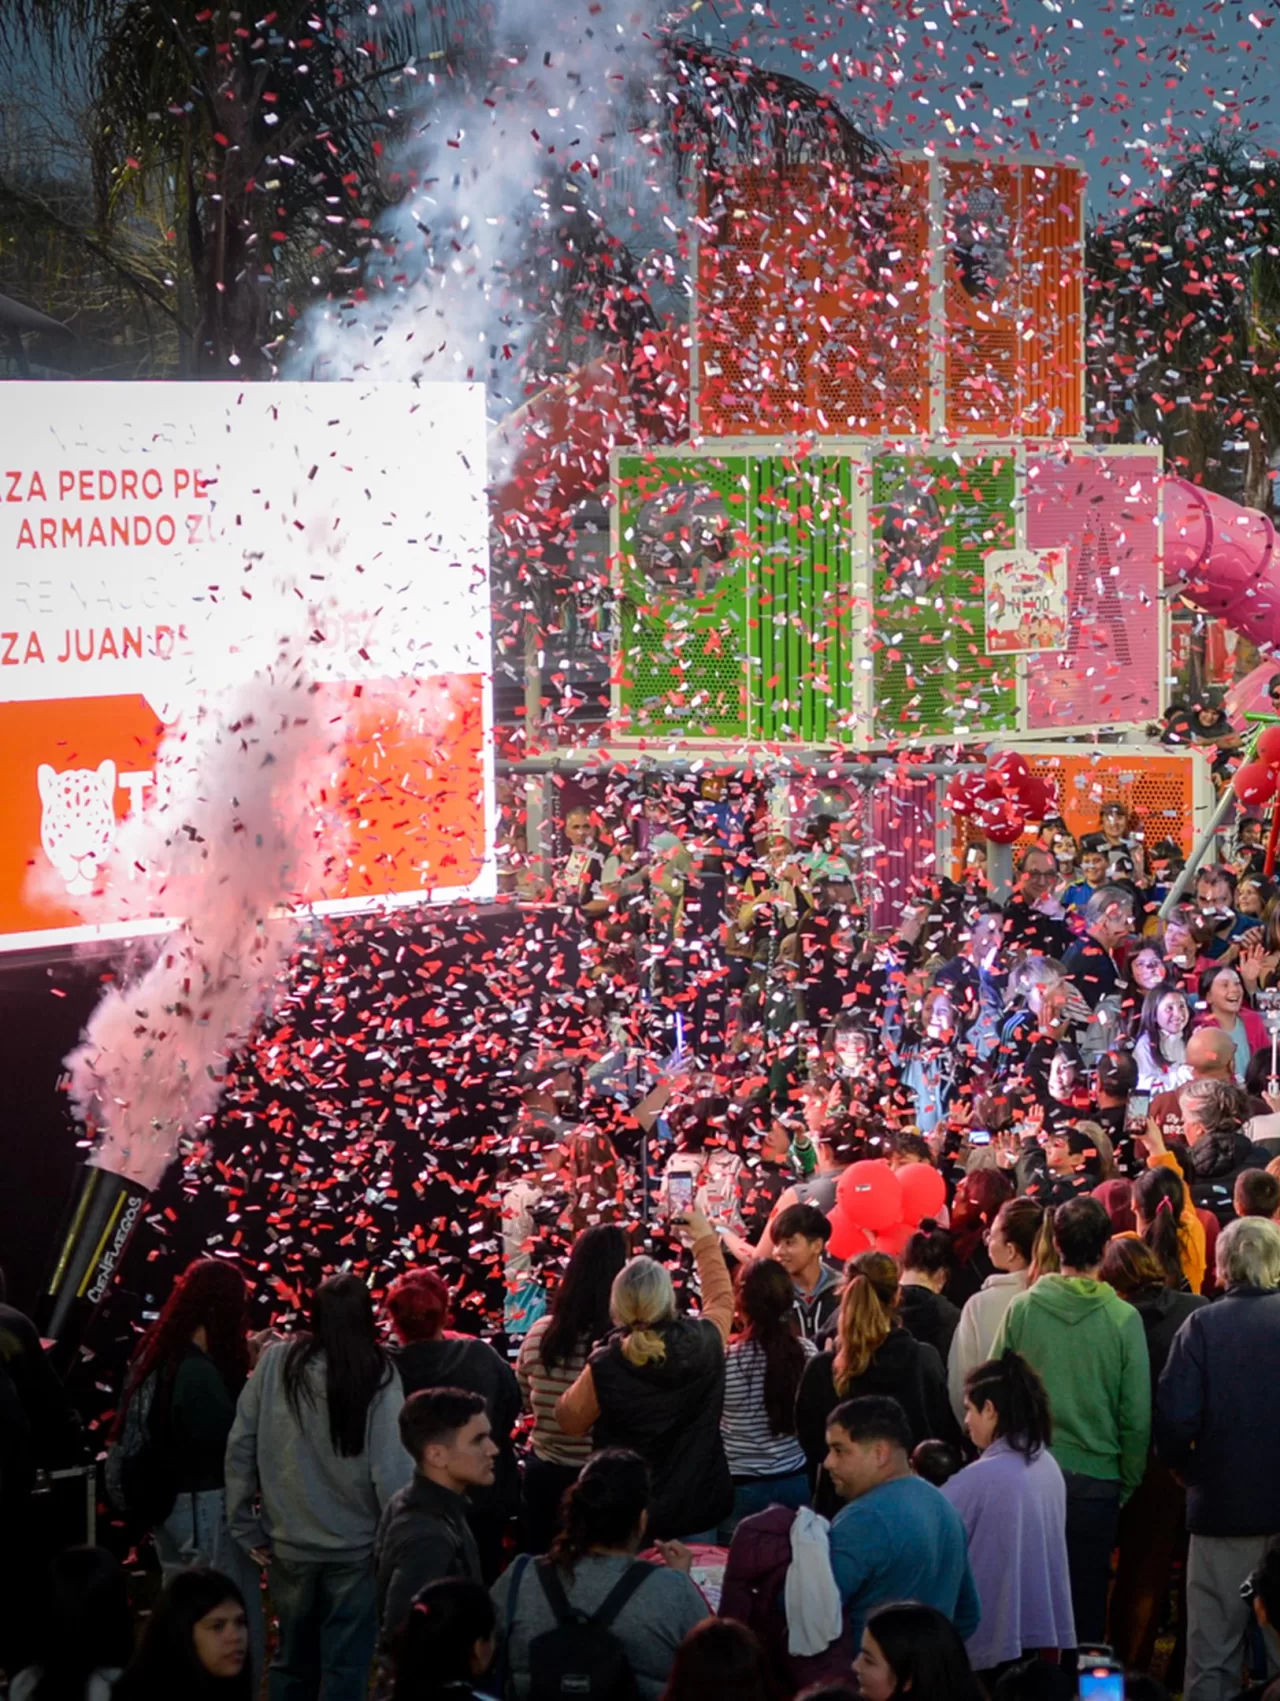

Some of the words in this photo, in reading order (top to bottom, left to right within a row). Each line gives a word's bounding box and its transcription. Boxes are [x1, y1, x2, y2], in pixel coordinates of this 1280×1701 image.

[0, 470, 47, 503] ZA
[58, 468, 163, 501] PEDRO
[16, 513, 176, 550] ARMANDO
[57, 625, 143, 663] JUAN
